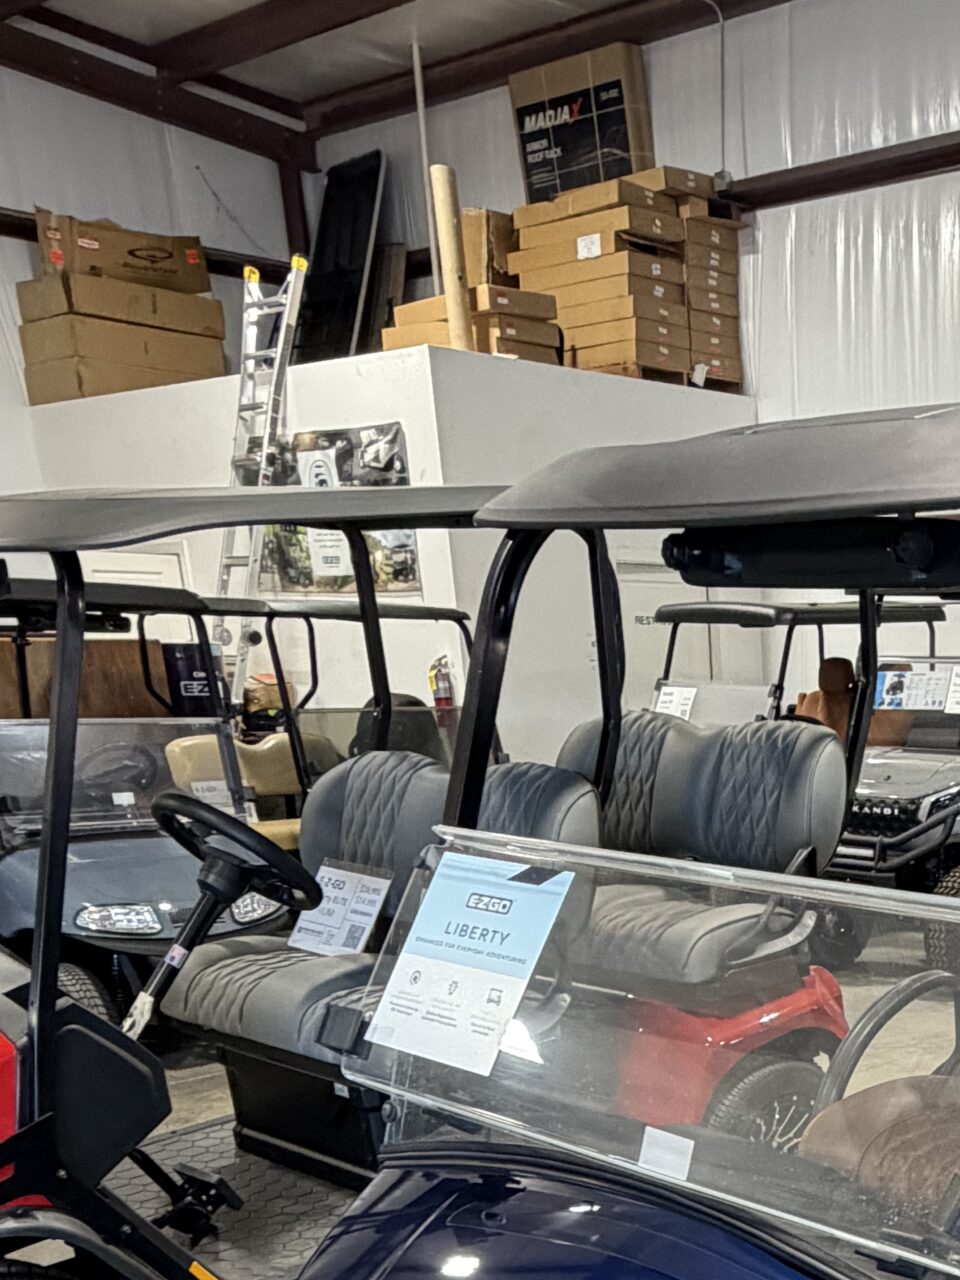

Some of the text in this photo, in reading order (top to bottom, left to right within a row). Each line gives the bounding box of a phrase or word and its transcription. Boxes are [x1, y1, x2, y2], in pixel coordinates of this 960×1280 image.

[852, 805, 899, 815] KANDI
[467, 893, 513, 914] EZGO
[444, 921, 511, 946] LIBERTY
